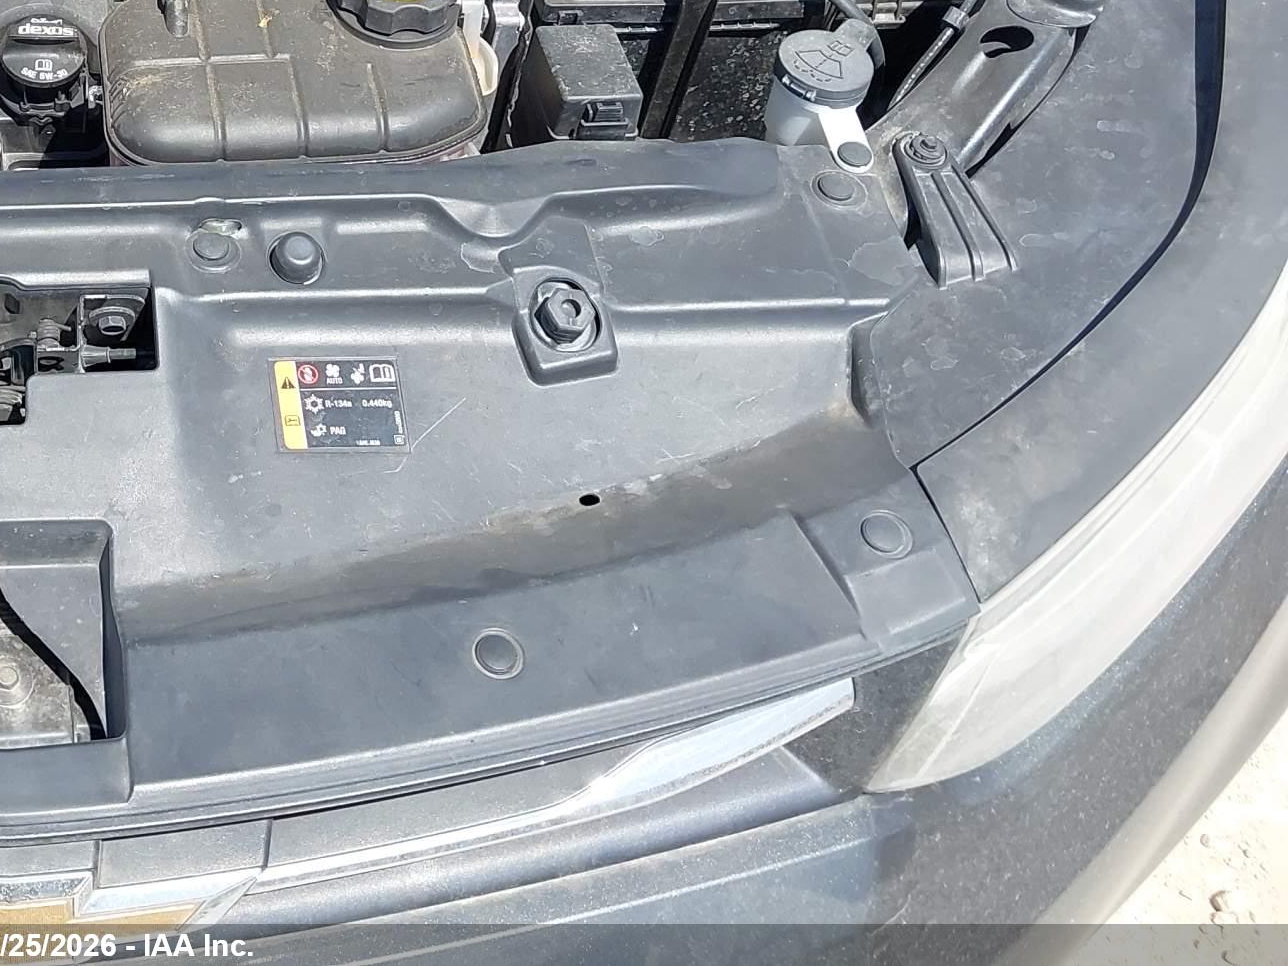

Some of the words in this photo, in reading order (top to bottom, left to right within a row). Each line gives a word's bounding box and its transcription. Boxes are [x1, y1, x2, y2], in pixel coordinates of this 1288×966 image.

[18, 22, 74, 36] dexos
[21, 67, 38, 79] SAE
[326, 377, 344, 385] AUTO
[325, 399, 353, 408] R-134a
[362, 399, 393, 409] 0.440kg
[329, 426, 347, 435] PAG
